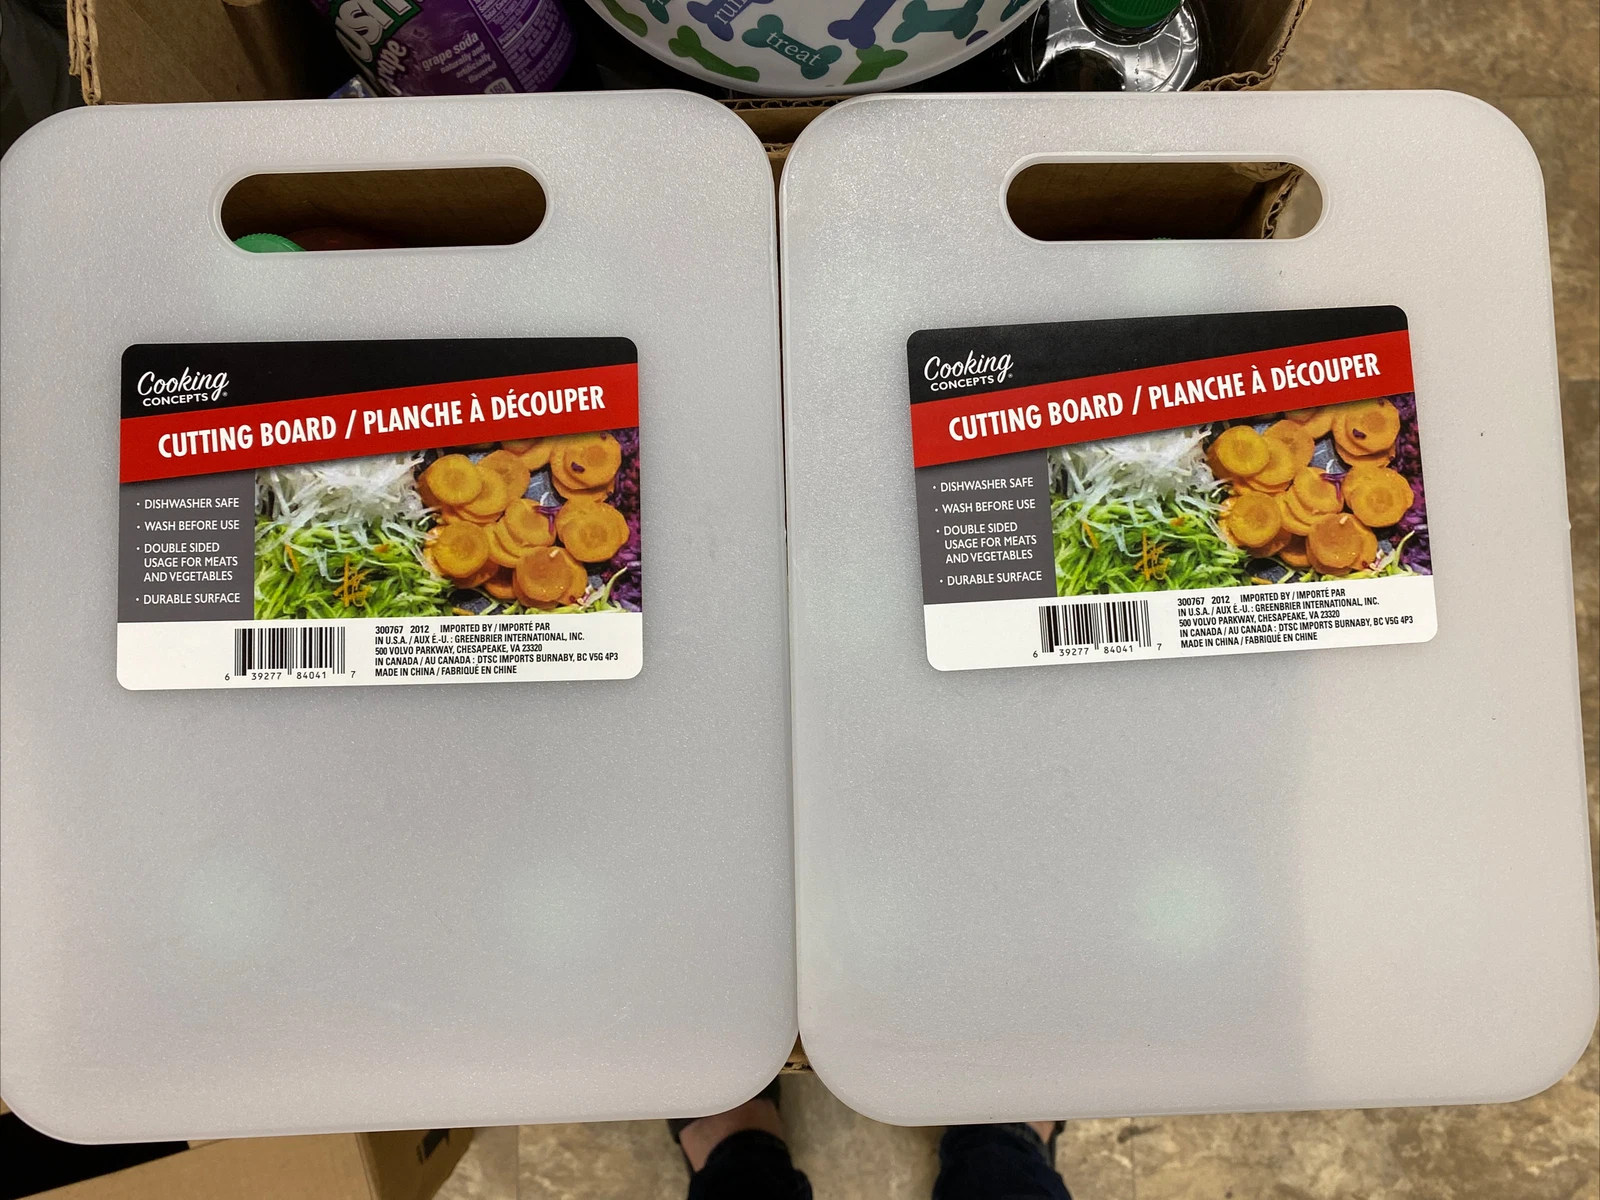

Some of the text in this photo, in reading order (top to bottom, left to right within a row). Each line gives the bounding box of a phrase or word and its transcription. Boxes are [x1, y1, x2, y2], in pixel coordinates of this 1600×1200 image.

[422, 32, 479, 72] grape soda
[766, 32, 821, 66] treat
[440, 41, 486, 74] naturally and
[924, 350, 1014, 383] Cooking
[137, 367, 229, 401] Cooking
[930, 375, 995, 392] CONCEPTS
[142, 392, 209, 407] CONCEPTS
[949, 352, 1381, 441] CUTTING BOARD / PLANCHE À DÉCOUPER
[158, 385, 606, 458] CUTTING BOARD / PLANCHE À DÉCOUPER
[940, 477, 1034, 492] DISHWASHER SAFE
[144, 497, 239, 509] DISHWASHER SAFE
[942, 499, 1036, 514] WASH BEFORE USE
[144, 520, 240, 531] WASH BEFORE USE
[943, 521, 1018, 536] DOUBLE SIDED
[144, 542, 220, 553] DOUBLE SIDED
[944, 535, 1037, 550] USAGE FOR MEATS
[144, 556, 238, 568] USAGE FOR MEATS
[945, 549, 1033, 564] AND VEGETABLES
[143, 571, 233, 582] AND VEGETABLES
[947, 570, 1042, 586] DURABLE SURFACE
[143, 592, 241, 605] DURABLE SURFACE
[1177, 597, 1205, 606] 300767
[1211, 595, 1230, 604] 2012
[1240, 592, 1279, 602] IMPORTED
[1280, 591, 1291, 600] BY
[1296, 587, 1330, 599] IMPORTÉ
[1331, 588, 1346, 597] PAR
[1178, 608, 1187, 617] IN
[1188, 607, 1210, 616] U.S.A.
[1216, 606, 1232, 615] AUX
[1255, 601, 1301, 612] GREENBRIER
[1303, 598, 1363, 609] INTERNATIONAL,
[1364, 596, 1380, 606] INC.
[1179, 609, 1340, 627] 500 VOLVO PARKWAY, CHESAPEAKE, VA 23320
[375, 625, 404, 634] 300767
[410, 625, 430, 633] 2012
[440, 624, 480, 633] IMPORTED
[482, 623, 493, 632] BY
[499, 621, 533, 632] IMPORTÉ
[535, 622, 550, 631] PAR
[1180, 629, 1188, 637] IN
[1190, 627, 1222, 637] CANADA
[1228, 626, 1239, 635] AU
[1241, 624, 1273, 634] CANADA
[1278, 622, 1298, 632] DTSC
[1299, 620, 1333, 630] IMPORTS
[1335, 618, 1372, 628] BURNABY,
[1373, 617, 1384, 626] BC
[1384, 616, 1399, 625] V5G
[1400, 615, 1414, 624] 4P3
[375, 636, 383, 645] IN
[385, 636, 408, 644] U.S.A.
[413, 635, 430, 644] AUX
[454, 634, 502, 643] GREENBRIER
[504, 632, 567, 642] INTERNATIONAL,
[569, 632, 585, 641] INC.
[1180, 639, 1203, 648] MADE
[1205, 638, 1214, 647] IN
[1215, 637, 1240, 647] CHINA
[1245, 633, 1282, 645] FABRIQUÉ
[1283, 633, 1293, 642] EN
[1295, 632, 1318, 641] CHINE
[375, 643, 543, 655] 500 VOLVO PARKWAY, CHESAPEAKE, VA 23320
[1032, 643, 1162, 658] 6 39277 84041 7
[375, 657, 383, 666] IN
[385, 656, 419, 665] CANADA
[424, 656, 436, 665] AU
[438, 655, 471, 664] CANADA
[477, 655, 498, 664] DTSC
[499, 654, 534, 663] IMPORTS
[536, 653, 575, 662] BURNABY,
[576, 653, 588, 661] BC
[589, 652, 603, 661] V5G
[605, 652, 618, 660] 4P3
[224, 670, 356, 681] 6 39277 84041 7
[375, 668, 398, 676] MADE
[400, 668, 408, 676] IN
[410, 667, 435, 676] CHINA
[441, 664, 479, 675] FABRIQUÉ
[481, 666, 491, 675] EN
[493, 665, 517, 674] CHINE
